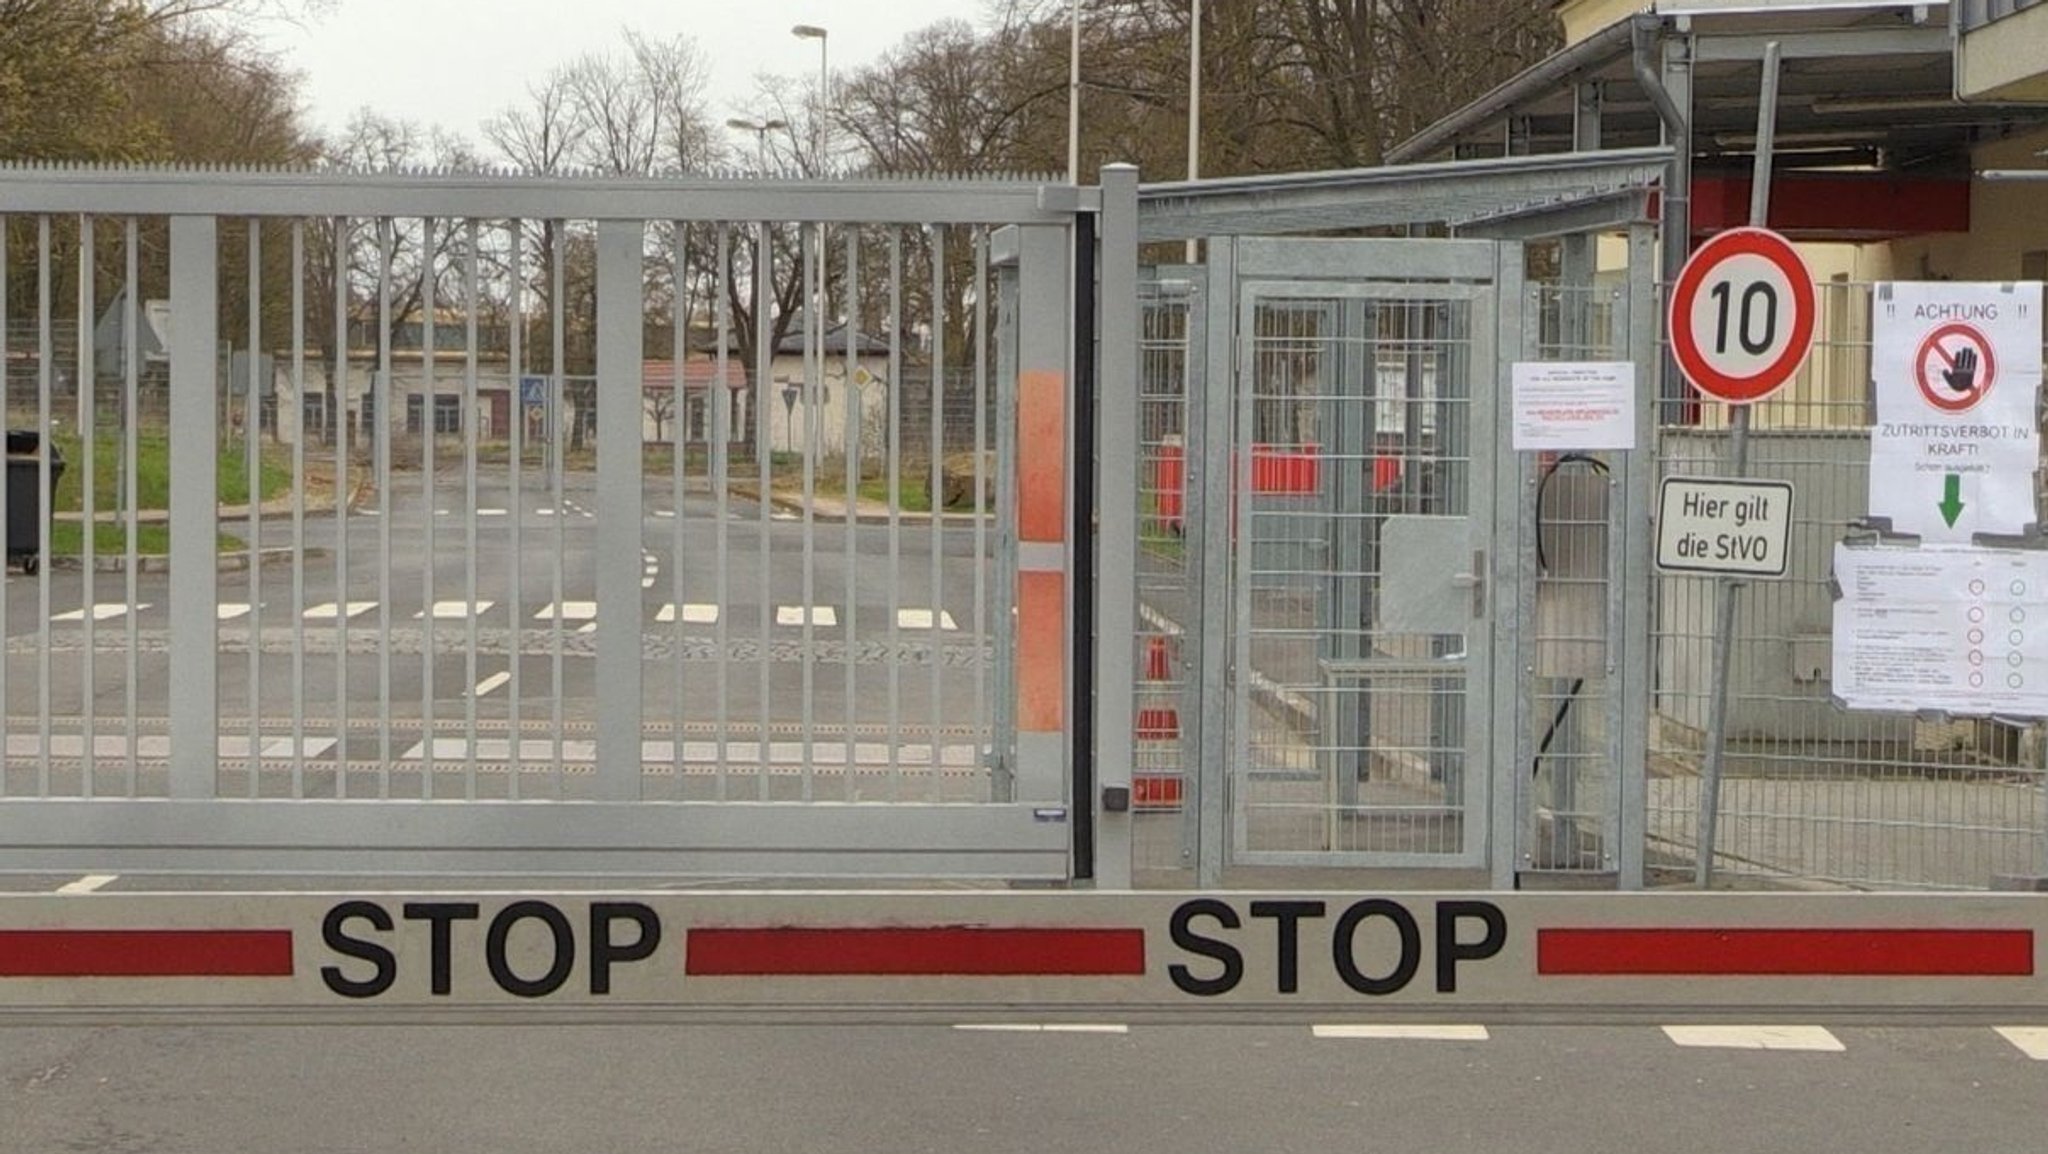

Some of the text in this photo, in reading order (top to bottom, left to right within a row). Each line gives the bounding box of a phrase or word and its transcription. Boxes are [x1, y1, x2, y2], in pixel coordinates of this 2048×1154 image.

[1711, 280, 1778, 356] 10
[1914, 303, 1999, 320] ACHTUNG
[1881, 423, 2030, 440] ZUTRITTSVERBOT IN
[1682, 491, 1768, 527] Hier gilt
[1676, 532, 1768, 562] die StVO
[320, 899, 662, 998] STOP
[1168, 898, 1508, 996] STOP
